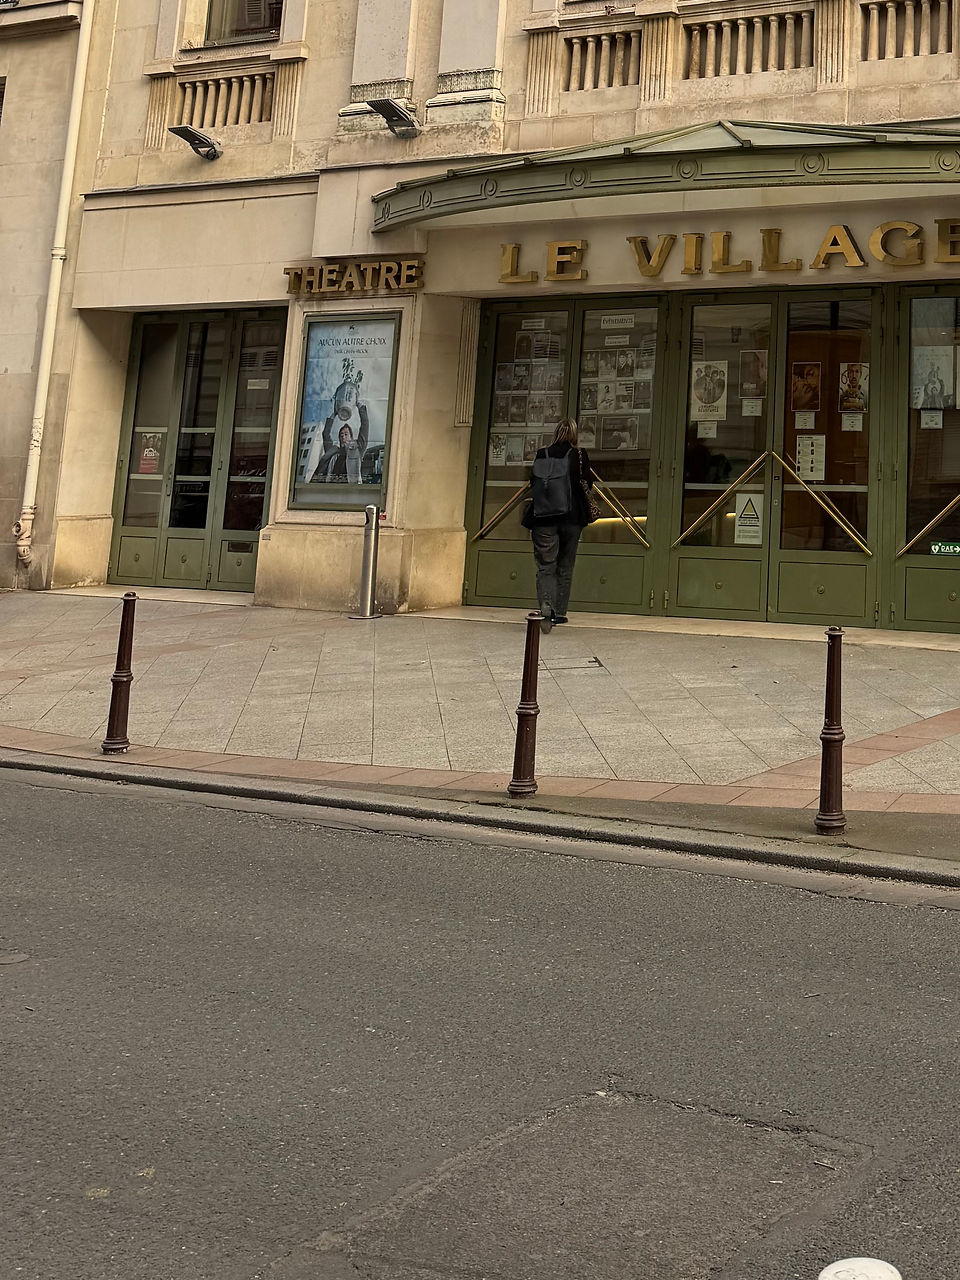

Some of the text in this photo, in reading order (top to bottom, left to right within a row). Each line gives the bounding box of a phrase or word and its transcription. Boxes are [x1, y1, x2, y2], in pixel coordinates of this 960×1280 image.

[283, 260, 425, 295] THEATRE
[498, 239, 588, 284] LE
[342, 337, 364, 345] AUTRE
[366, 337, 386, 345] CHOIX
